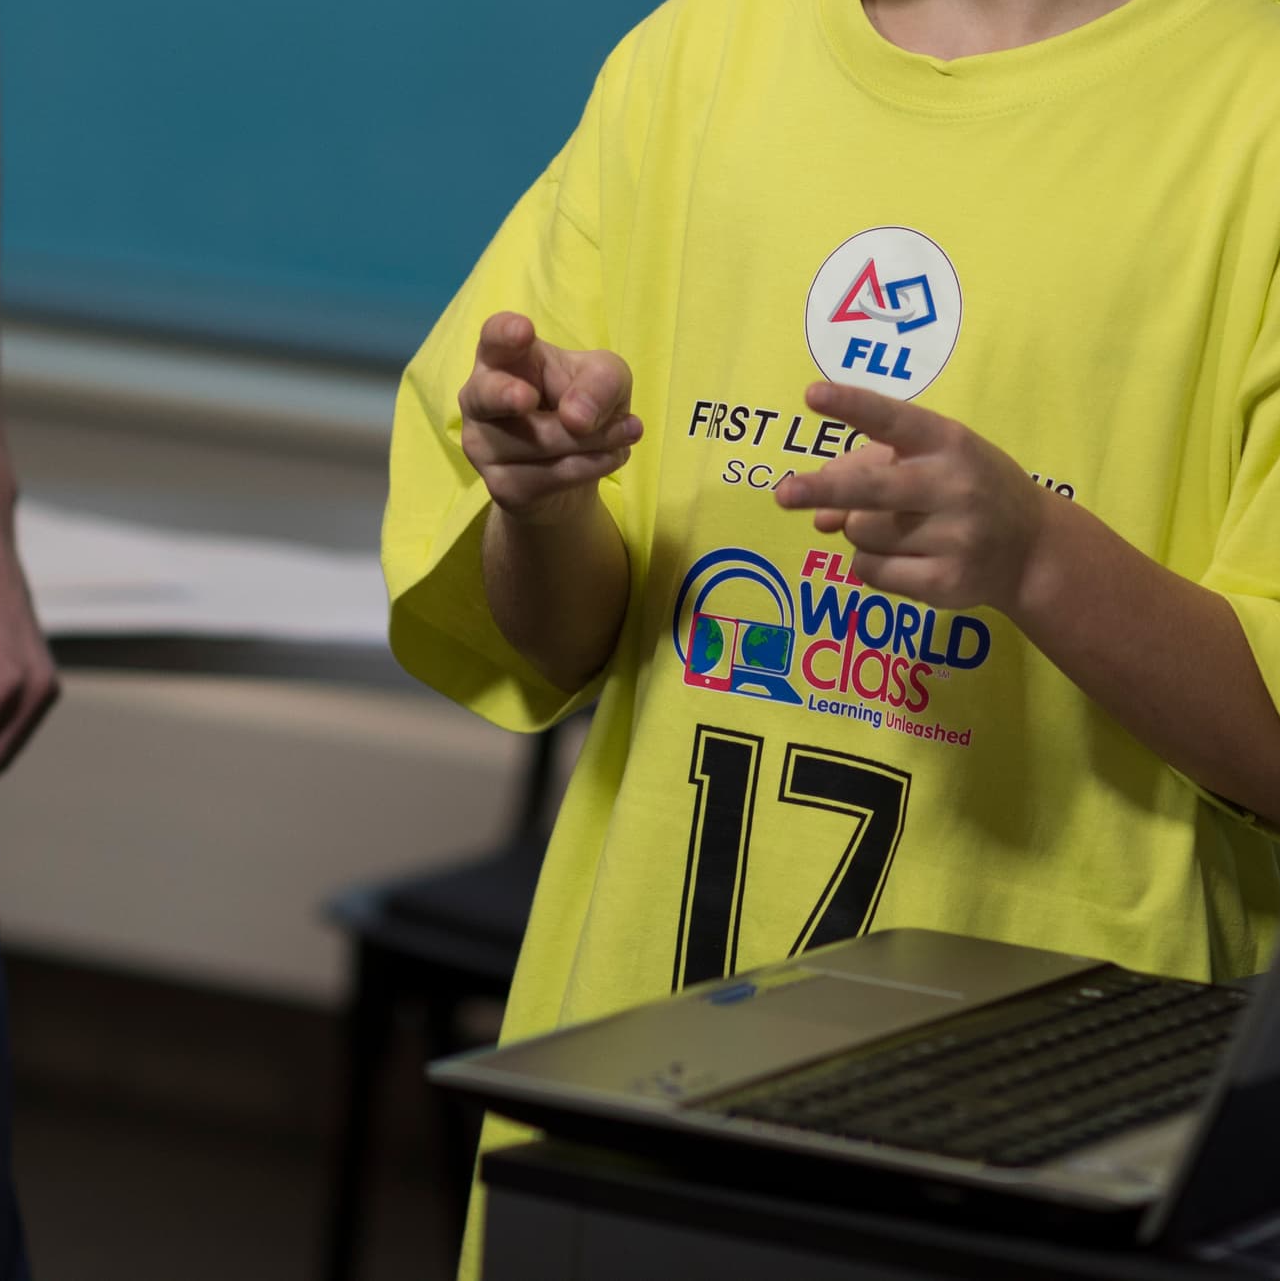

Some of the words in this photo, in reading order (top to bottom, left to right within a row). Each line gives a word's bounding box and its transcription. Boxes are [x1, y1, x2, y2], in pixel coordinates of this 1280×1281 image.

[841, 337, 912, 380] FLL
[688, 400, 779, 446] FIRST
[800, 581, 991, 670] WORLD
[808, 694, 883, 728] Learning
[886, 710, 972, 746] Unleashed
[671, 723, 912, 995] 17
